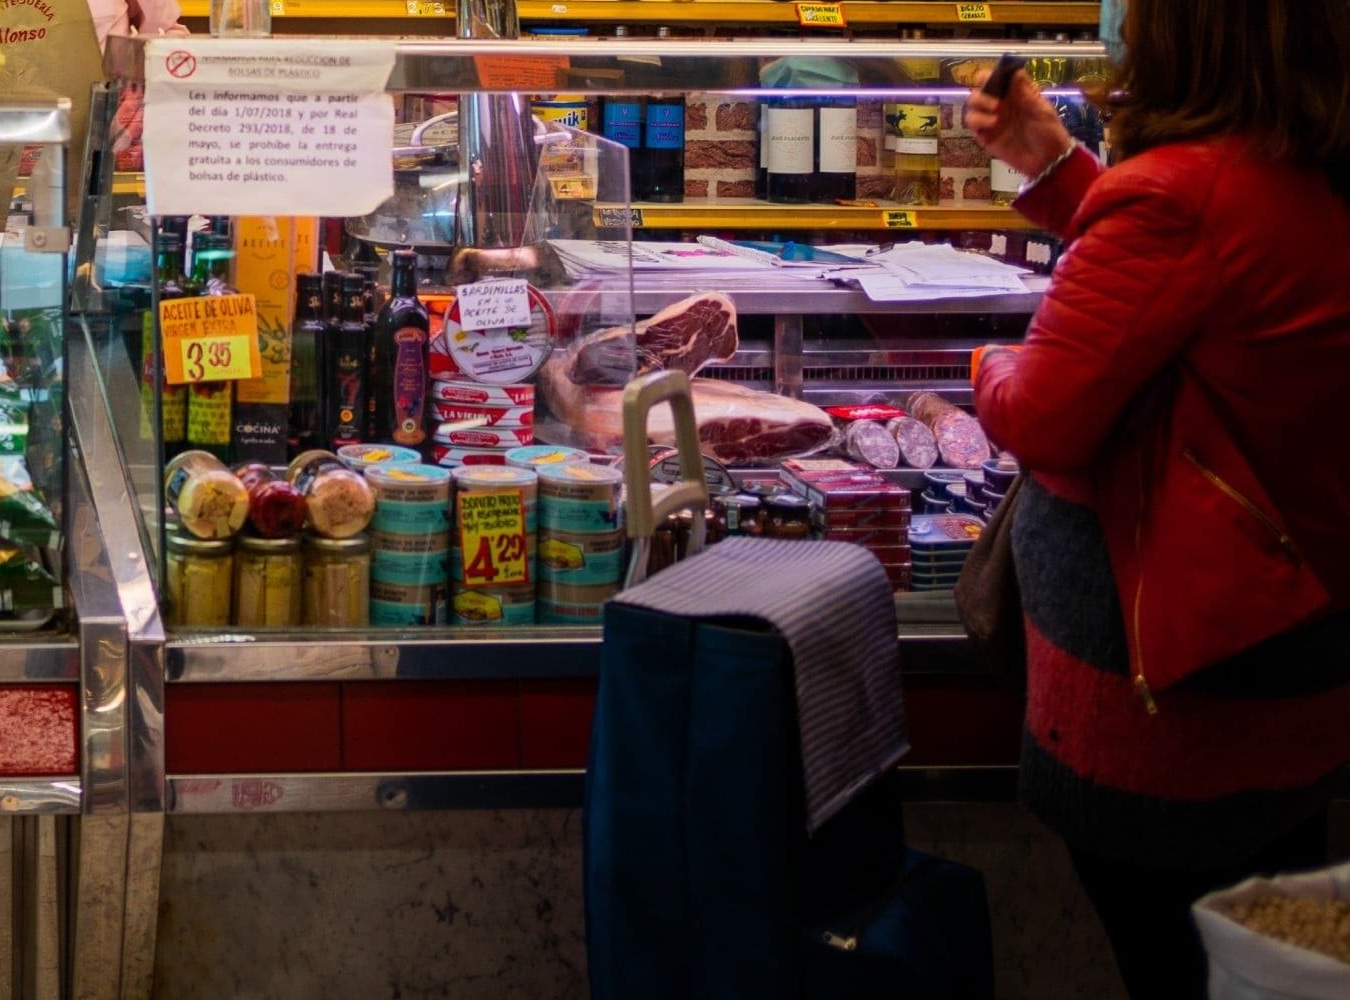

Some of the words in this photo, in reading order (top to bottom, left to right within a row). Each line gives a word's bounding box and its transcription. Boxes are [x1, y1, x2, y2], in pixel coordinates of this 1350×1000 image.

[188, 91, 206, 101] Les
[213, 91, 279, 101] informamos
[287, 94, 308, 104] que
[328, 93, 359, 104] partir
[188, 107, 206, 117] del
[235, 107, 292, 119] 1/07/2018
[310, 111, 328, 120] por
[335, 109, 358, 119] Real
[188, 123, 231, 133] Decreto
[302, 125, 315, 134] de
[323, 125, 337, 135] 18
[344, 126, 357, 135] de
[188, 142, 222, 151] mayo,
[229, 141, 243, 151] se
[298, 140, 308, 150] la
[315, 142, 357, 152] entrega
[188, 156, 231, 167] gratuita
[245, 156, 261, 166] los
[264, 157, 340, 167] consumidores
[343, 158, 357, 167] de
[189, 171, 224, 181] bolsas
[227, 172, 240, 181] de
[462, 286, 525, 298] SARDINILLAS
[163, 302, 201, 321] ACEITE
[204, 300, 219, 318] DE
[220, 298, 254, 316] OLIVA
[204, 320, 236, 335] EXTRA
